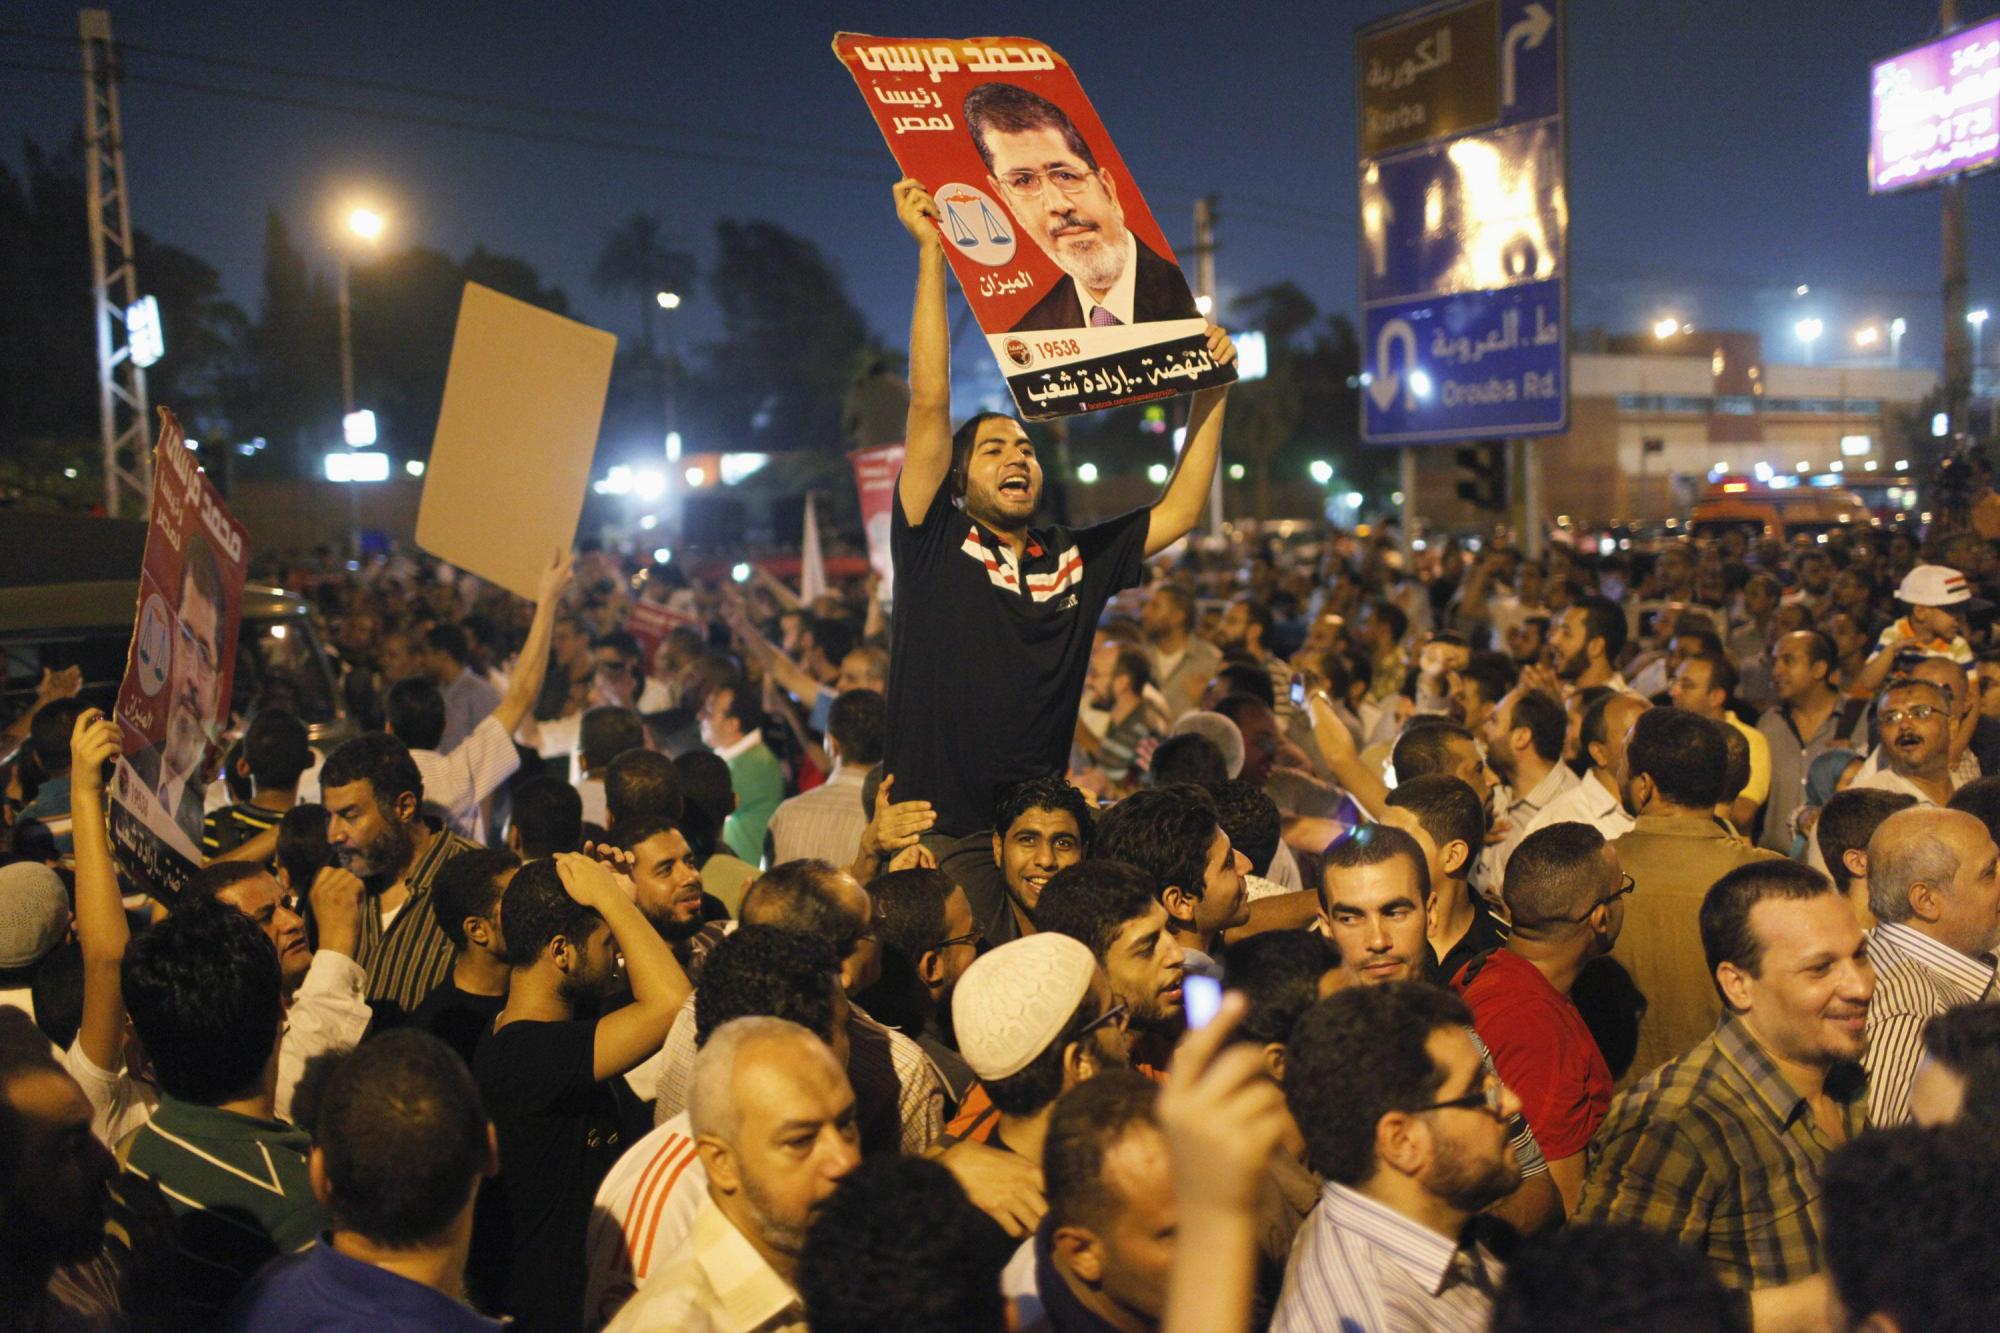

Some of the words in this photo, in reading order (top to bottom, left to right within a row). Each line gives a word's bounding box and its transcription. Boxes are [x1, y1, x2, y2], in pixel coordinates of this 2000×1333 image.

[962, 46, 1056, 72] محمد
[892, 113, 955, 134] لمصر
[979, 270, 1034, 297] الميزان
[1035, 338, 1081, 360] 19538
[1027, 370, 1079, 407] شعب
[201, 491, 242, 563] محمد
